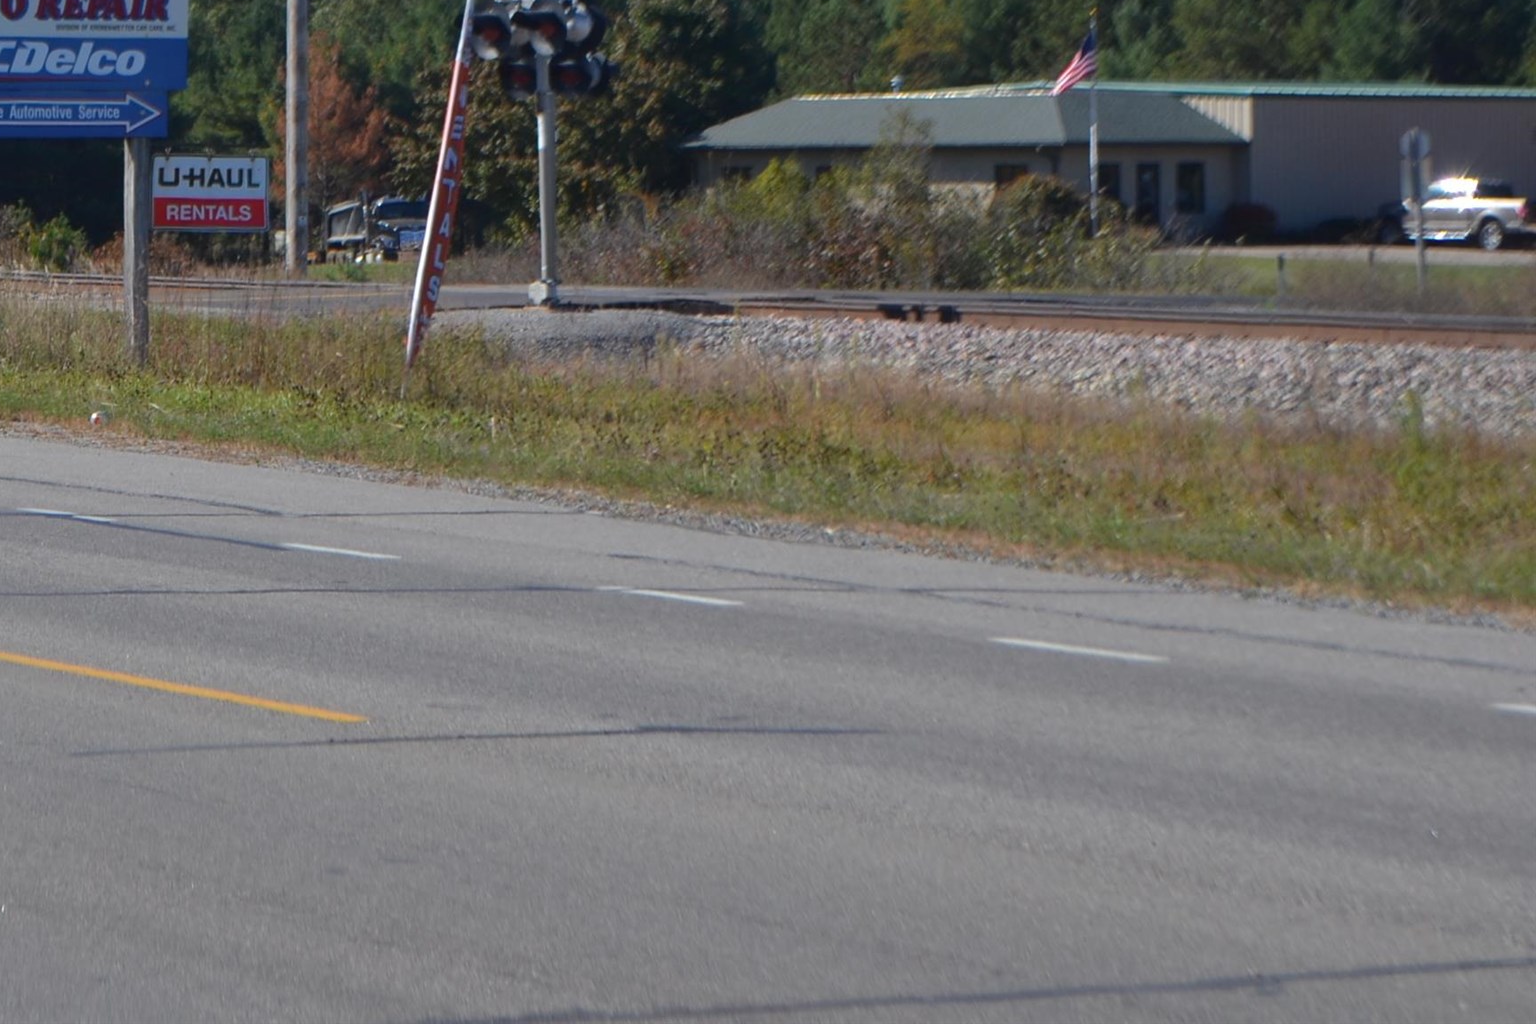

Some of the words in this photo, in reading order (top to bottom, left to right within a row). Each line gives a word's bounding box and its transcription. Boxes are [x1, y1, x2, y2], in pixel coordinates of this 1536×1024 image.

[9, 105, 73, 120] Automotive
[78, 106, 121, 120] Service
[158, 167, 261, 188] U-HAUL
[166, 204, 252, 222] RENTALS
